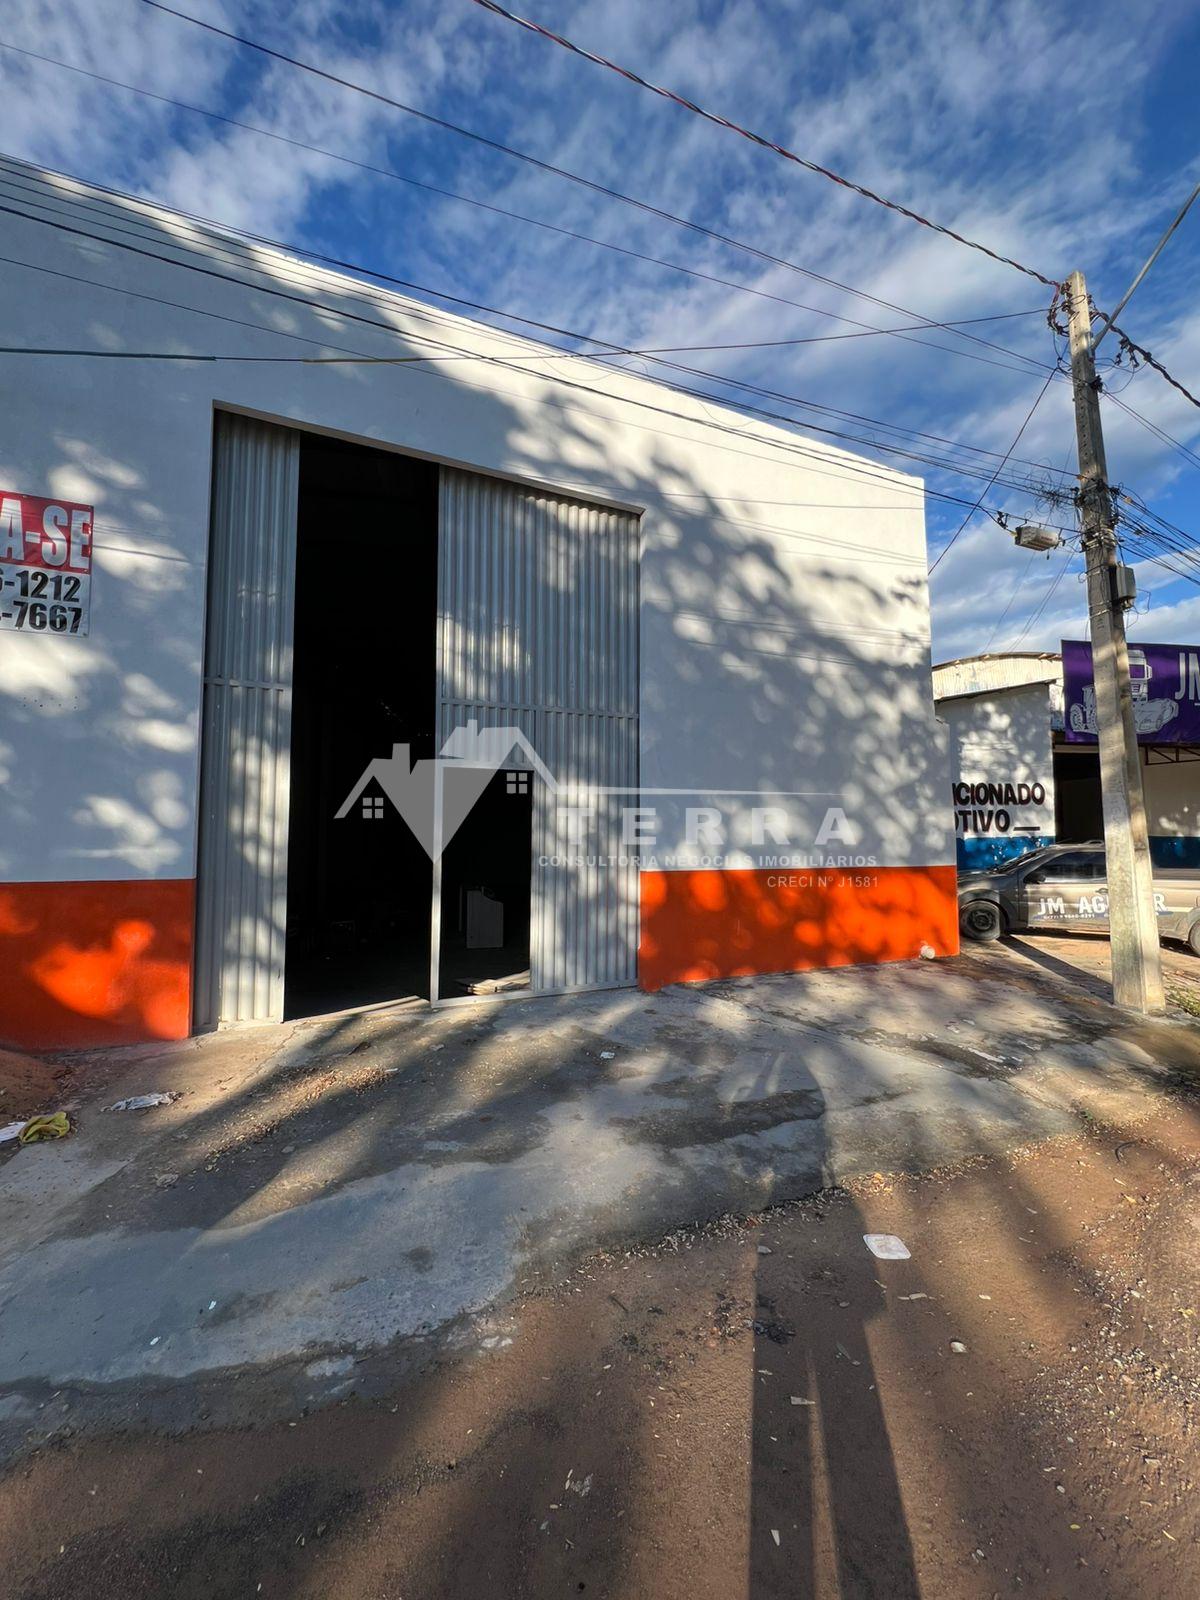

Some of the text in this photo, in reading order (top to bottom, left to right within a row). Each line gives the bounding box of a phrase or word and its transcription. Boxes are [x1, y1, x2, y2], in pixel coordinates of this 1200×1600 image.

[0, 497, 92, 568] A-SE
[0, 568, 81, 602] -1212
[0, 601, 82, 633] -7667
[1037, 897, 1066, 916] JM
